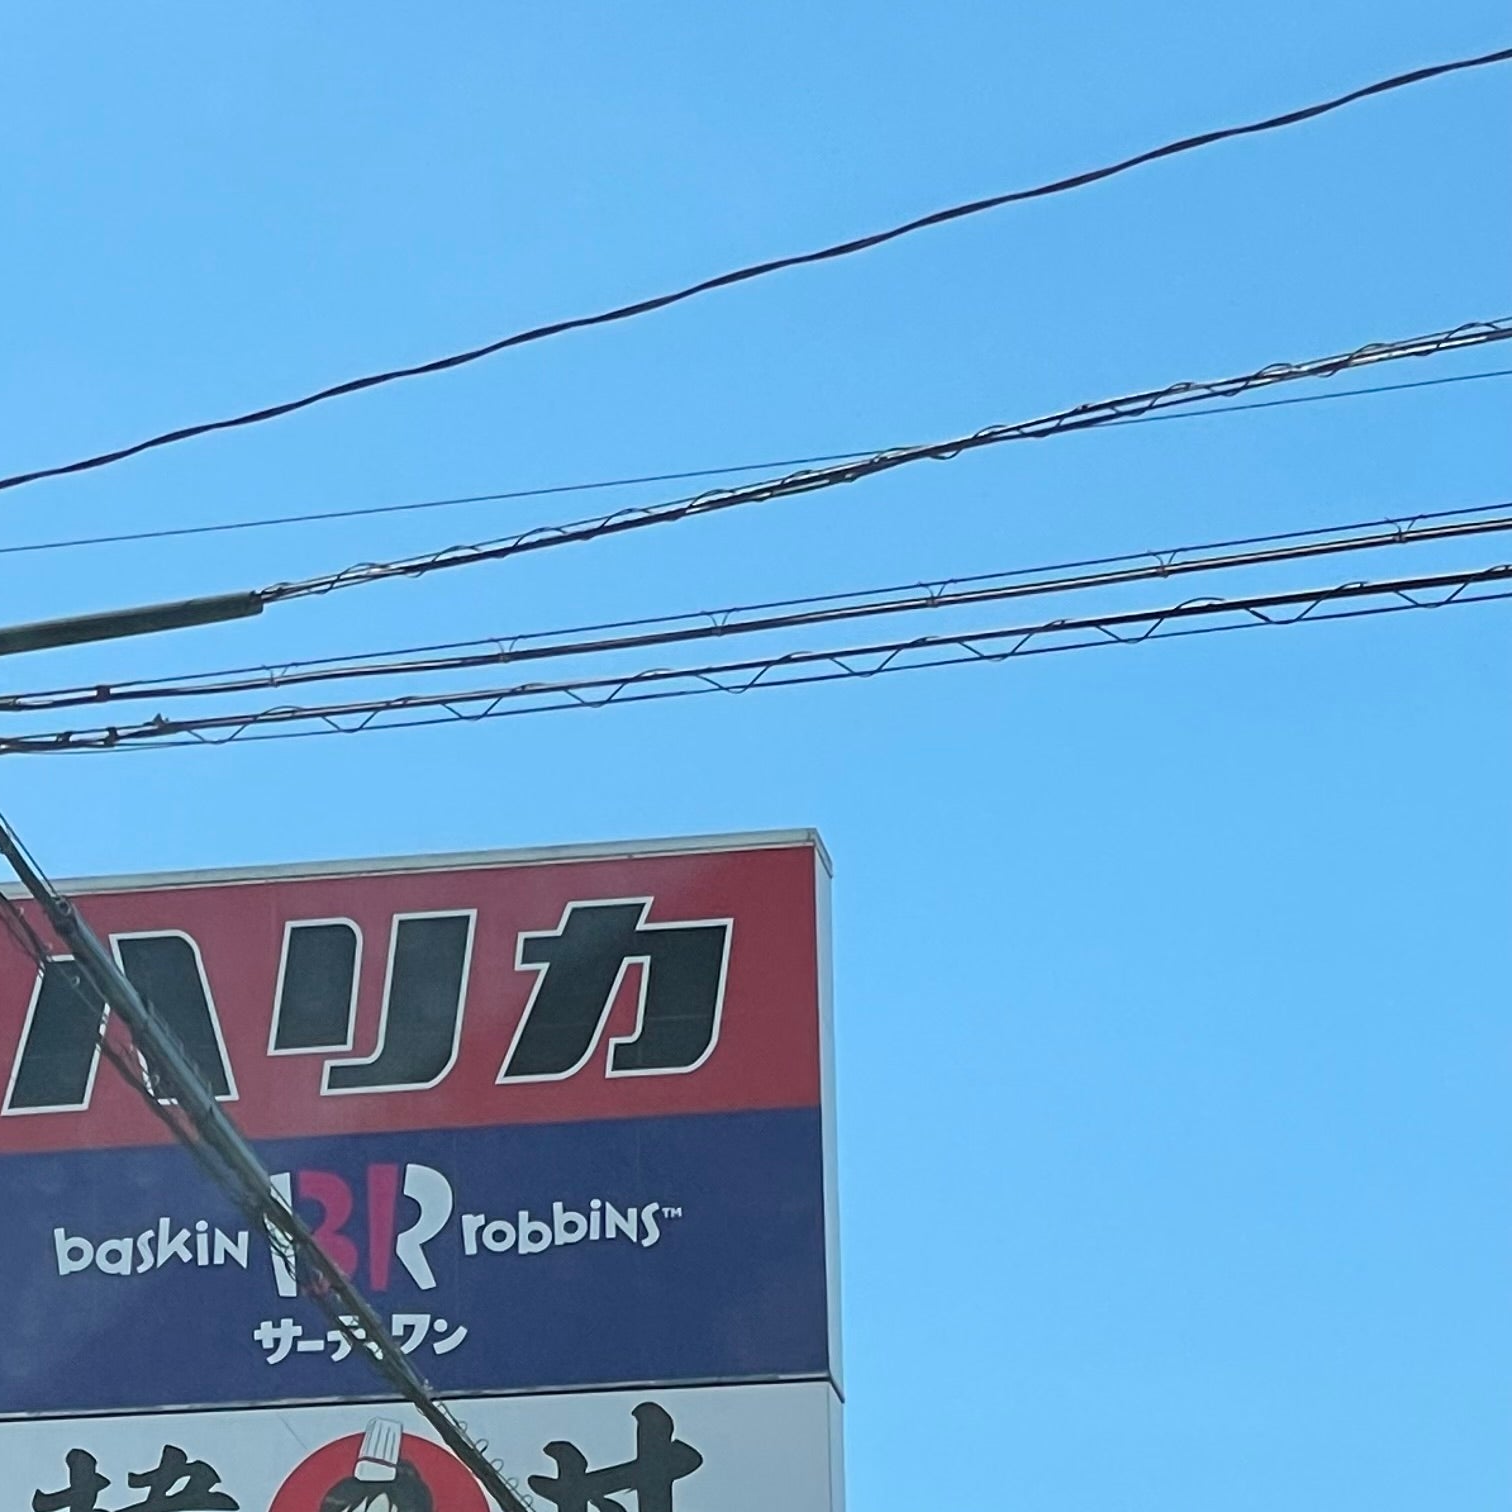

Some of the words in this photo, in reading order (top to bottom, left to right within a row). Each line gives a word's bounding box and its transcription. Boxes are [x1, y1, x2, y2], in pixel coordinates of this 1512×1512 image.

[1, 895, 734, 1116] ハリカ
[55, 1217, 248, 1276] baskin
